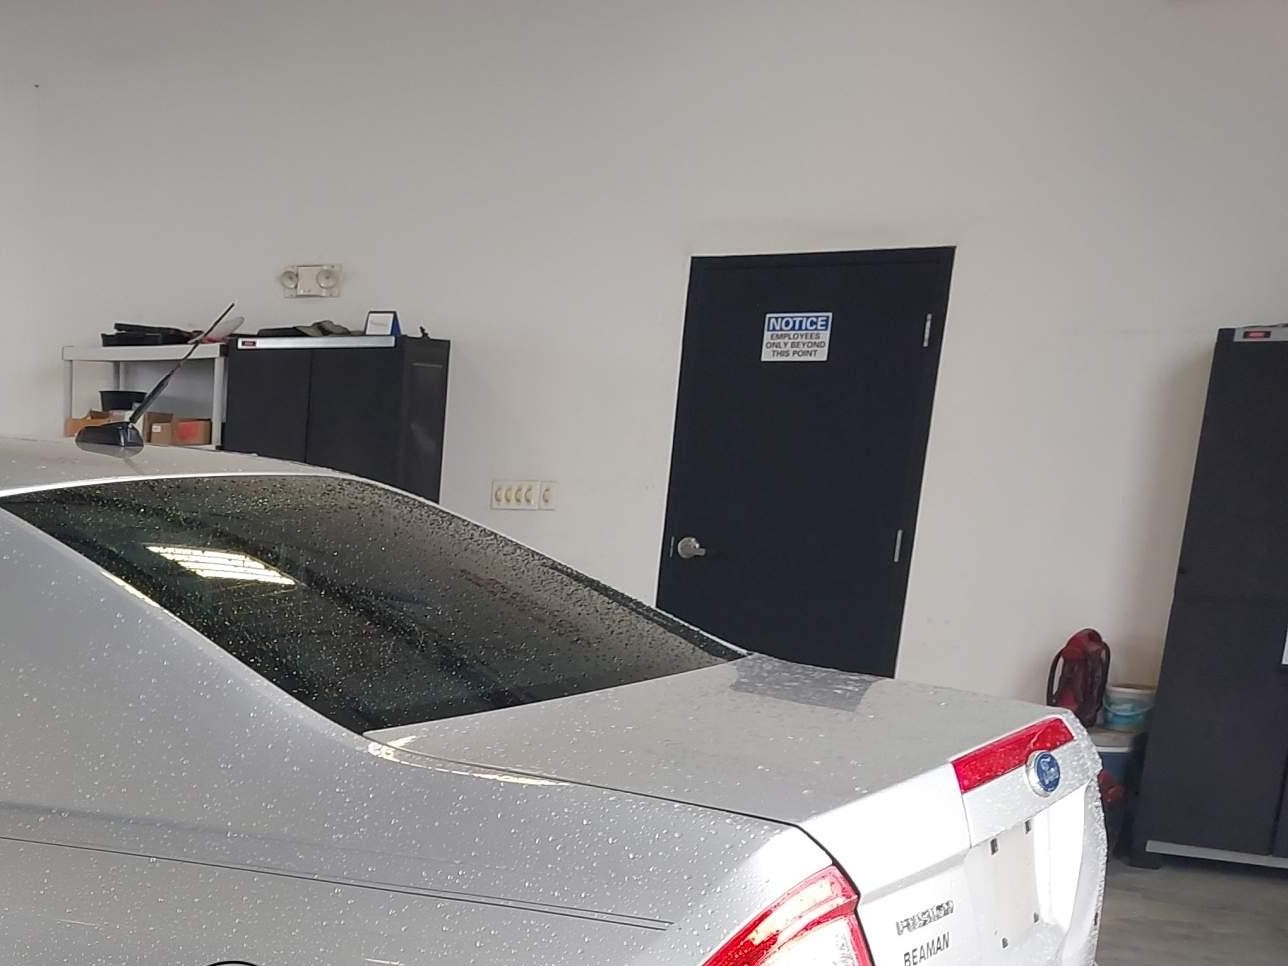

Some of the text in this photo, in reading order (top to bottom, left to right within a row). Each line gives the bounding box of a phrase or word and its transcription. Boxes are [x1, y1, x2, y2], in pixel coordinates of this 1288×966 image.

[769, 316, 827, 330] NOTICE
[765, 341, 826, 349] ONLY BEYOND
[792, 349, 819, 357] POINT
